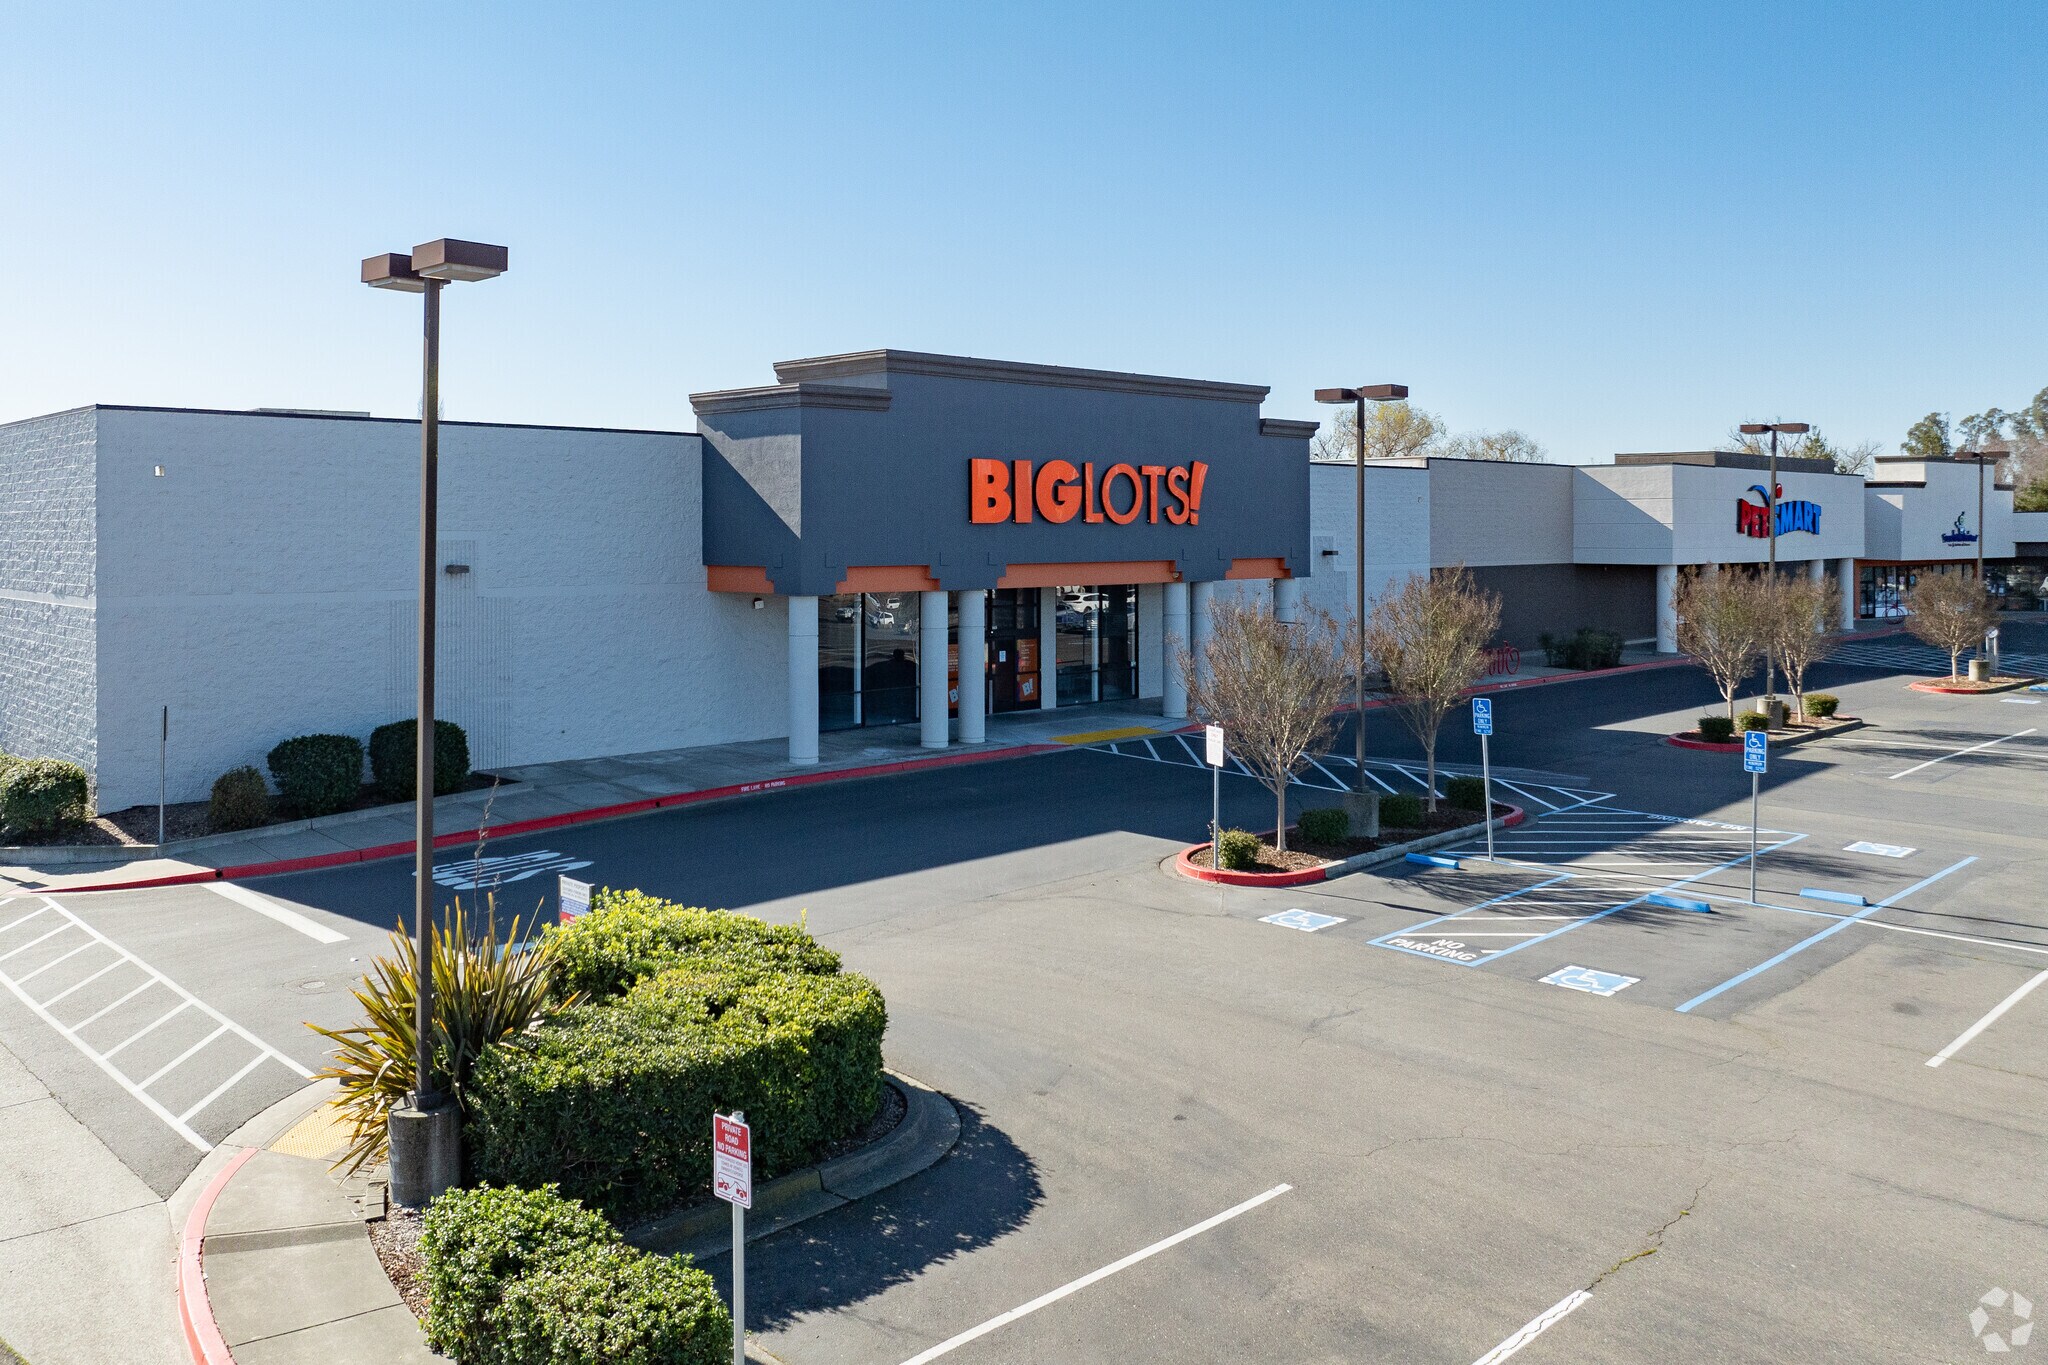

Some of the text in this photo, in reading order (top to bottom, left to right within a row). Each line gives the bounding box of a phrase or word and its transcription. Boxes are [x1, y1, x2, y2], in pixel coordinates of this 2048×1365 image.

[1386, 938, 1477, 961] PARKING
[1431, 939, 1465, 949] NO
[721, 1122, 742, 1137] PRIVATE
[724, 1133, 739, 1146] ROAD
[717, 1141, 747, 1160] NO PARKING
